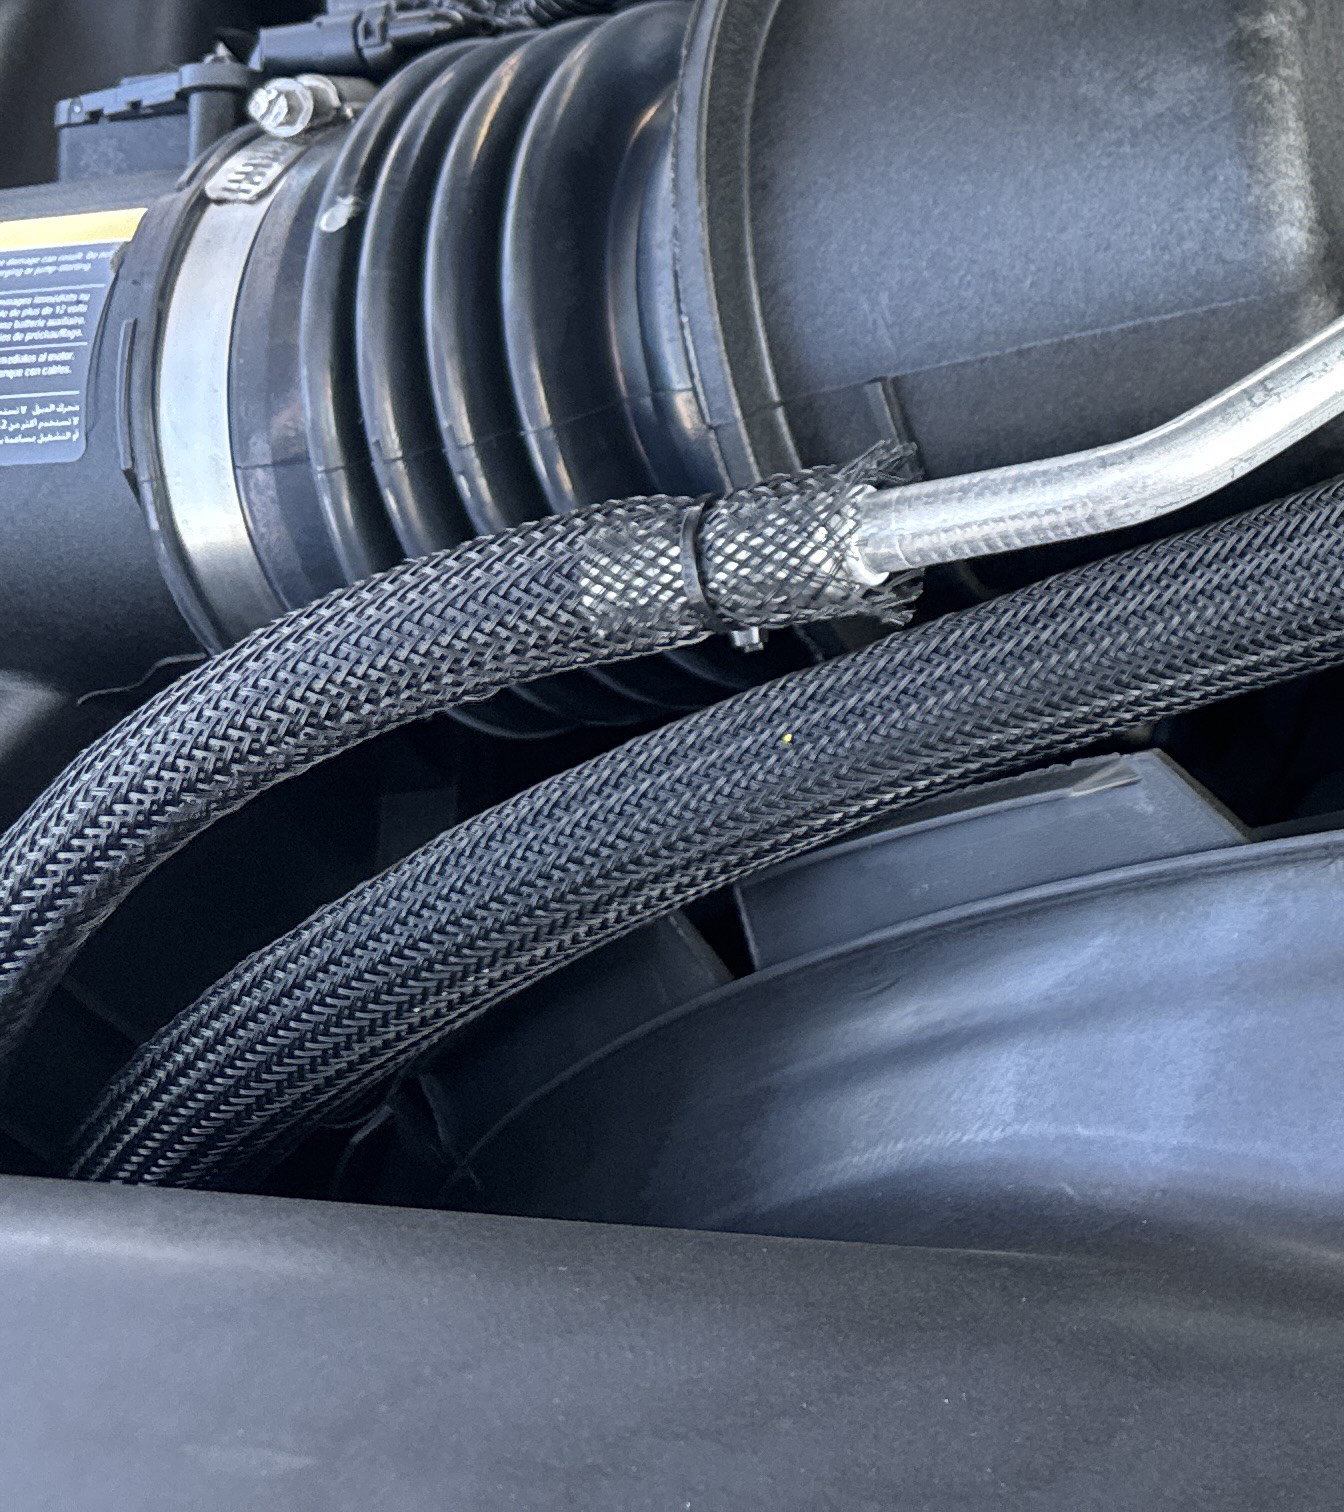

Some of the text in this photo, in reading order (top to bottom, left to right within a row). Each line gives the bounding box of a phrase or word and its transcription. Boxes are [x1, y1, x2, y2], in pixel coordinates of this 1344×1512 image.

[41, 306, 53, 315] de
[55, 304, 67, 314] 12
[37, 352, 48, 363] al
[24, 368, 41, 377] con
